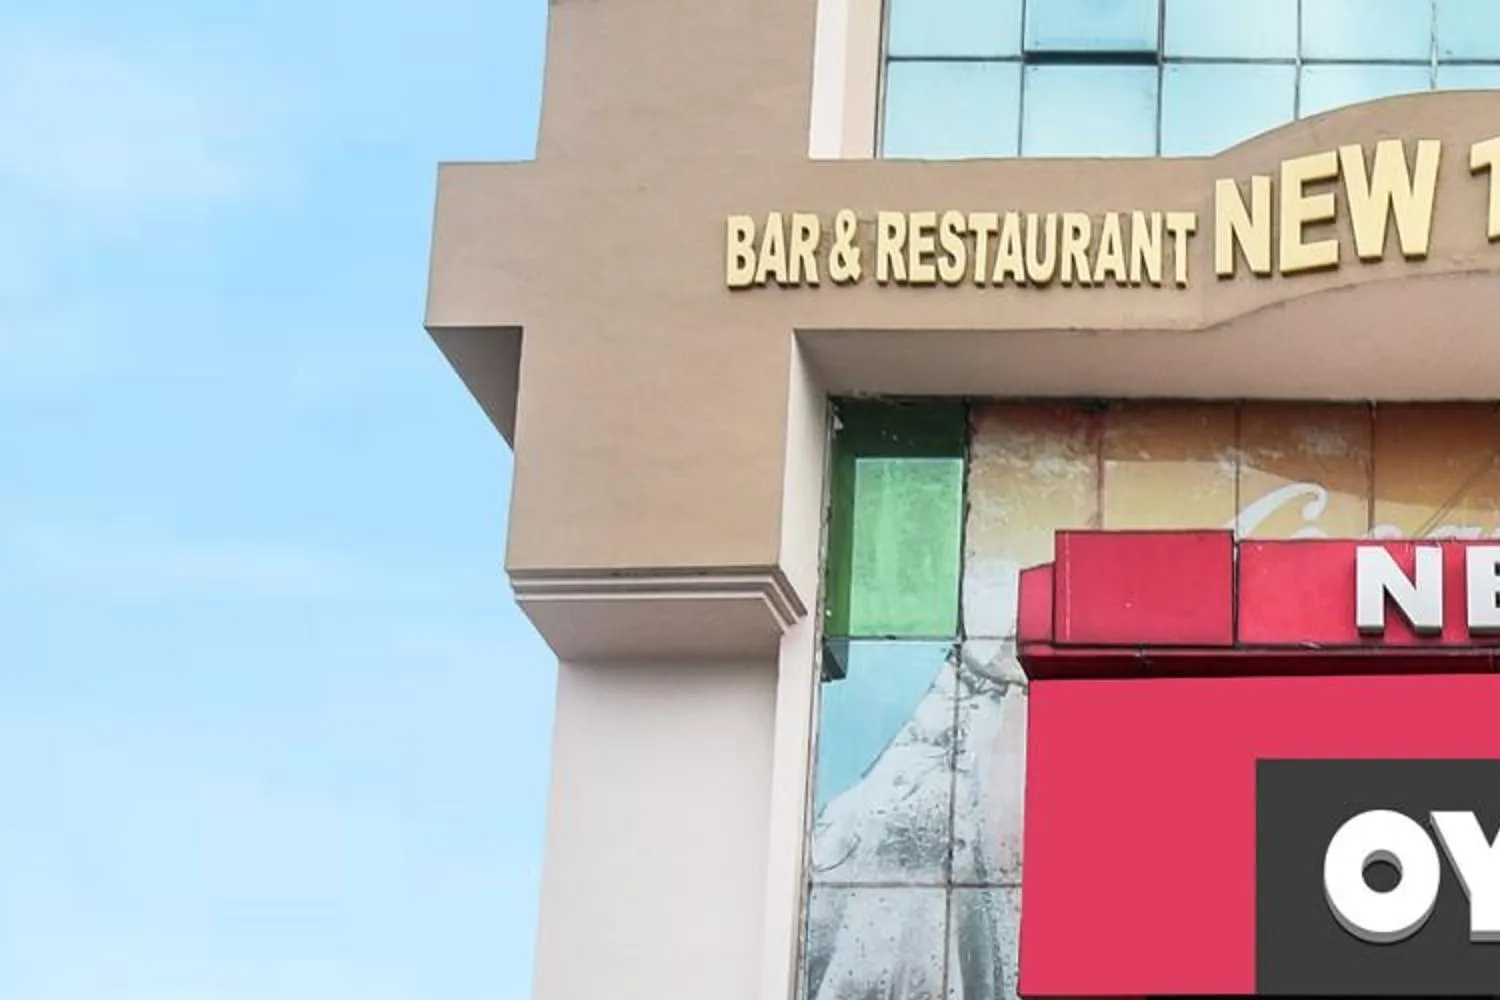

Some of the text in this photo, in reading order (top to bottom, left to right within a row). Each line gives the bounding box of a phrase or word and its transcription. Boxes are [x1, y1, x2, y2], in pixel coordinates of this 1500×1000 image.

[725, 209, 1197, 290] BAR & RESTAURANT
[1215, 139, 1442, 278] NEW
